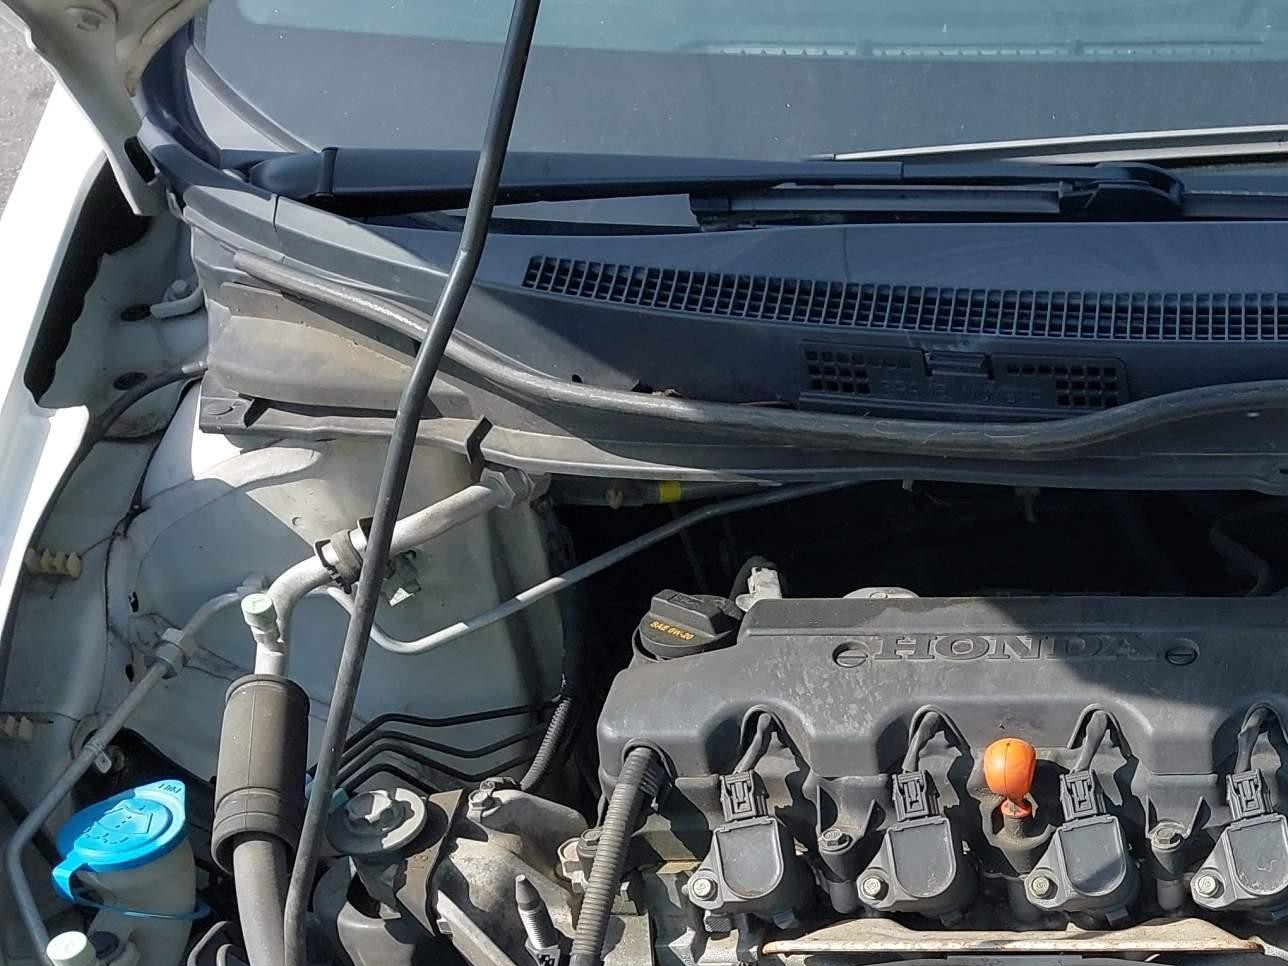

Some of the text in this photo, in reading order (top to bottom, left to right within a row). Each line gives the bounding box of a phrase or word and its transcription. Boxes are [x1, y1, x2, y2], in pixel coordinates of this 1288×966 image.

[650, 621, 695, 641] SAE 0W-20
[873, 634, 1158, 662] HONDA
